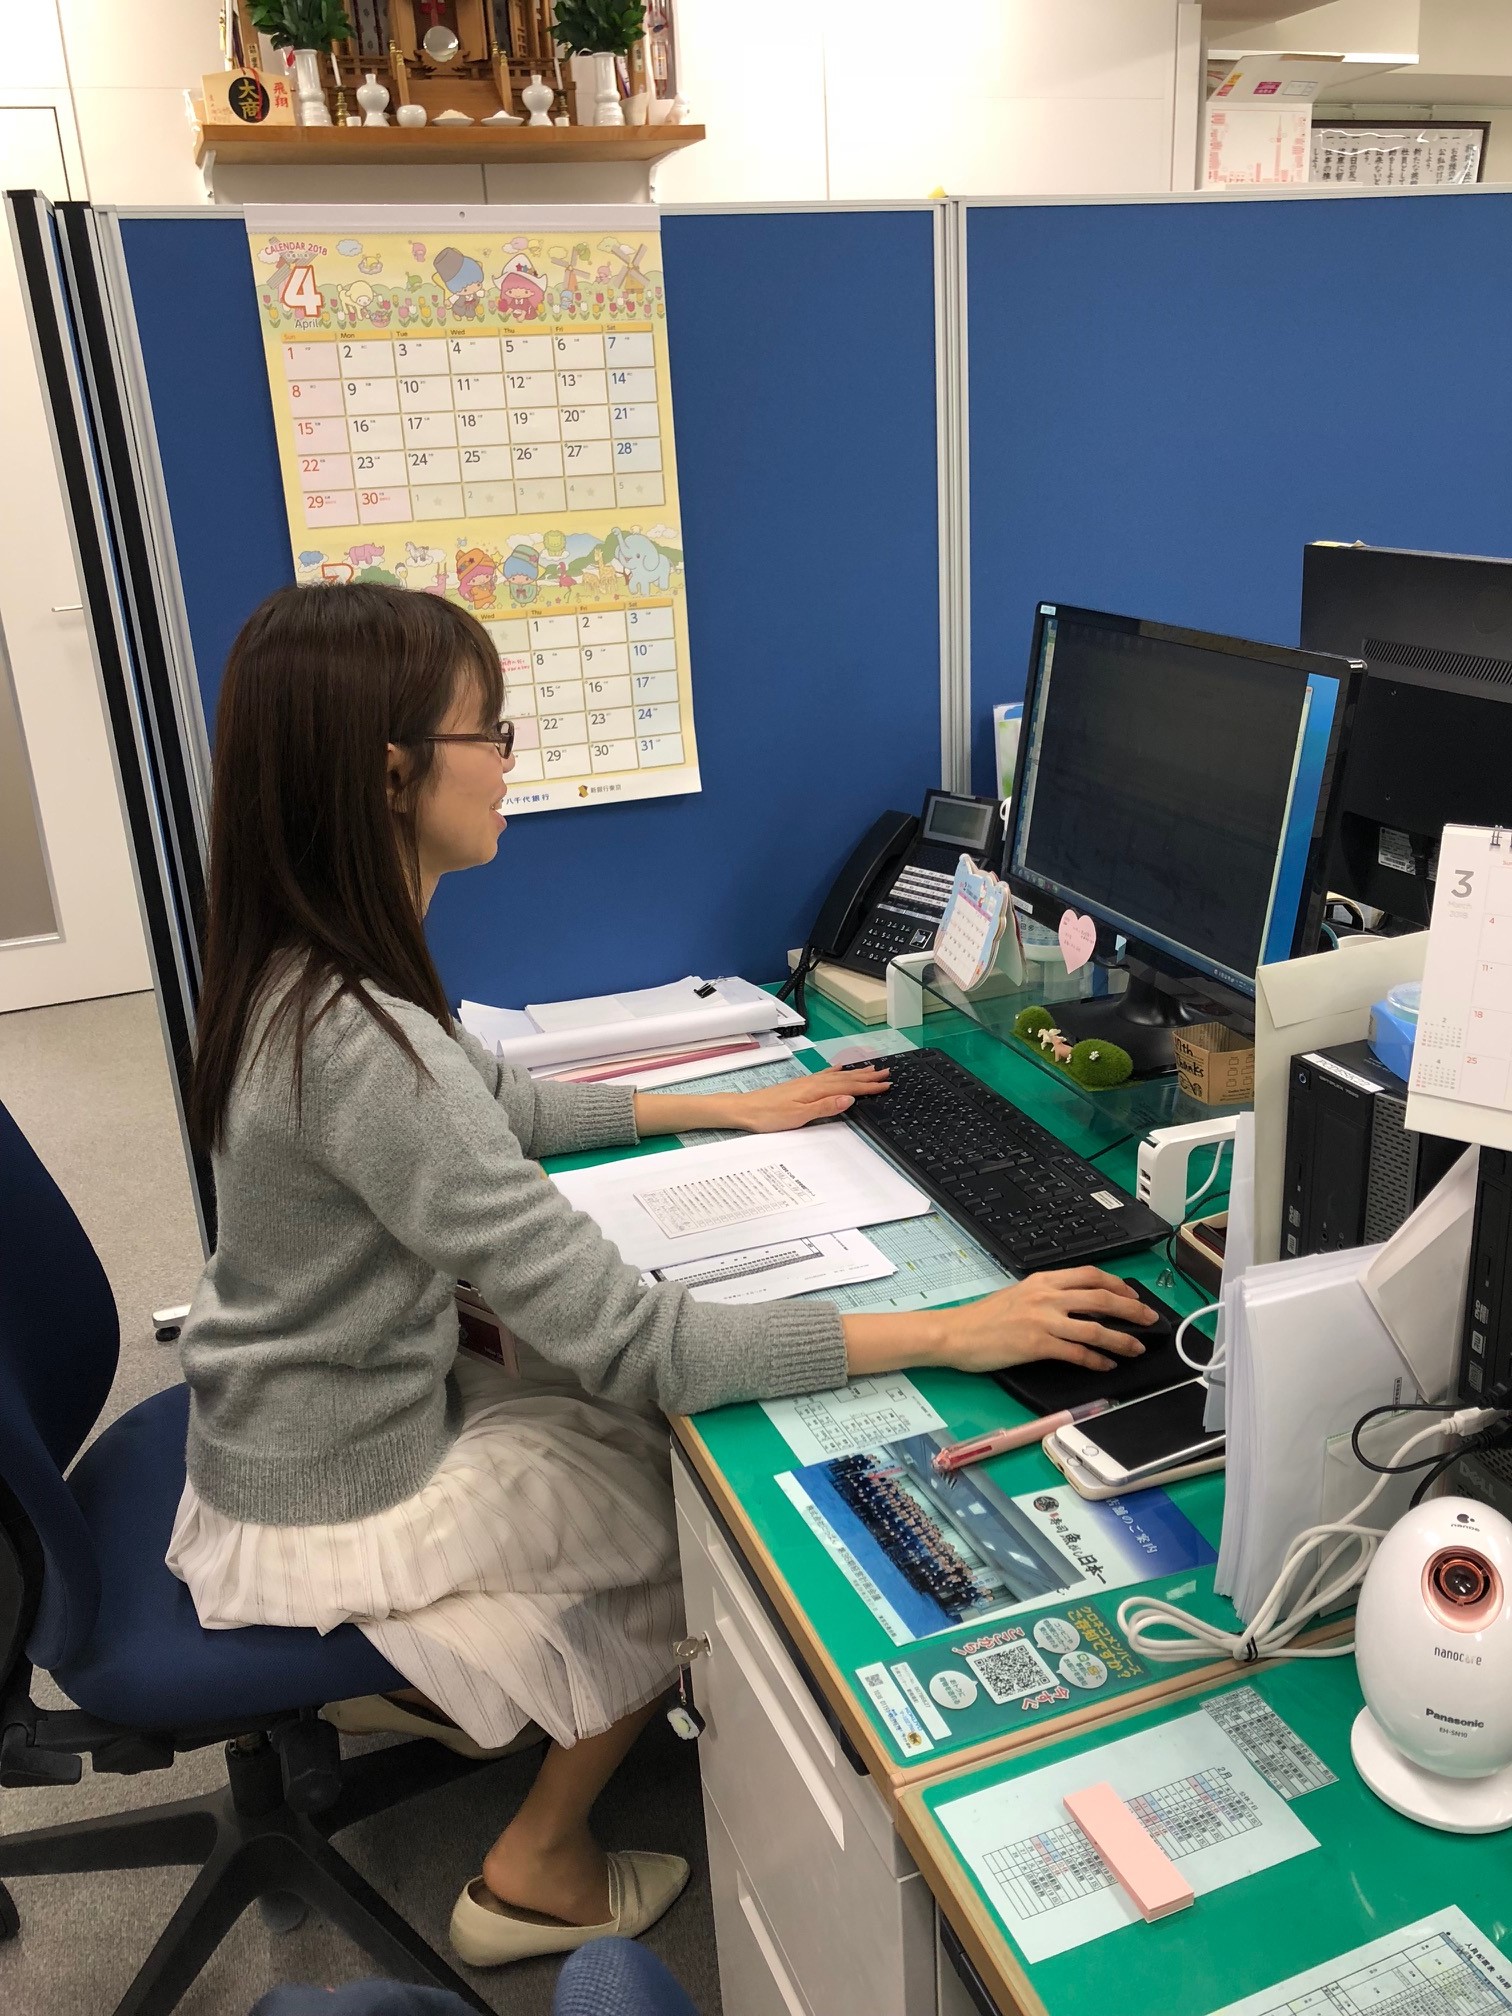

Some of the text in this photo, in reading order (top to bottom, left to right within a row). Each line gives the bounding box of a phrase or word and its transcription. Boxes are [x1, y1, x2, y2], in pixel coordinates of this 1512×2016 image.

[273, 81, 288, 108] 飛翔
[264, 242, 305, 256] CALENDAR
[307, 242, 328, 256] 2018
[281, 264, 324, 318] 4
[294, 318, 319, 330] April
[287, 336, 617, 360] 1 2 3 4 5 6 7
[291, 372, 627, 398] 8 9 10 11 12 13 14
[297, 407, 628, 436] 15 16 17 18 19 20 21
[302, 442, 633, 473] 22 23 24 25 26 27 28
[307, 481, 624, 509] 29 30 1 2 3 4 5
[480, 612, 495, 620] Wed
[533, 612, 639, 633] 1 2 3
[536, 644, 648, 666] 8 9 10
[539, 676, 650, 699] 15 16 17
[542, 708, 653, 731] 22 23 24
[546, 739, 654, 763] 29 30 31
[505, 794, 550, 805] 八千代銀行
[590, 784, 622, 795] 新銀行東京
[1451, 869, 1475, 898] 3
[1449, 910, 1469, 919] 2018
[1481, 964, 1489, 972] 11
[1474, 1010, 1484, 1019] 18
[1466, 1056, 1478, 1065] 25
[1049, 1517, 1069, 1534] 寿司
[1060, 1532, 1107, 1585] 魚がし日本一
[1080, 1606, 1144, 1676] クロネコメンバーズ
[1021, 1685, 1070, 1710] 今すぐ
[1425, 1707, 1485, 1729] Panasonic
[1438, 1726, 1468, 1739] EH-SN10
[1215, 1765, 1234, 1779] 2月
